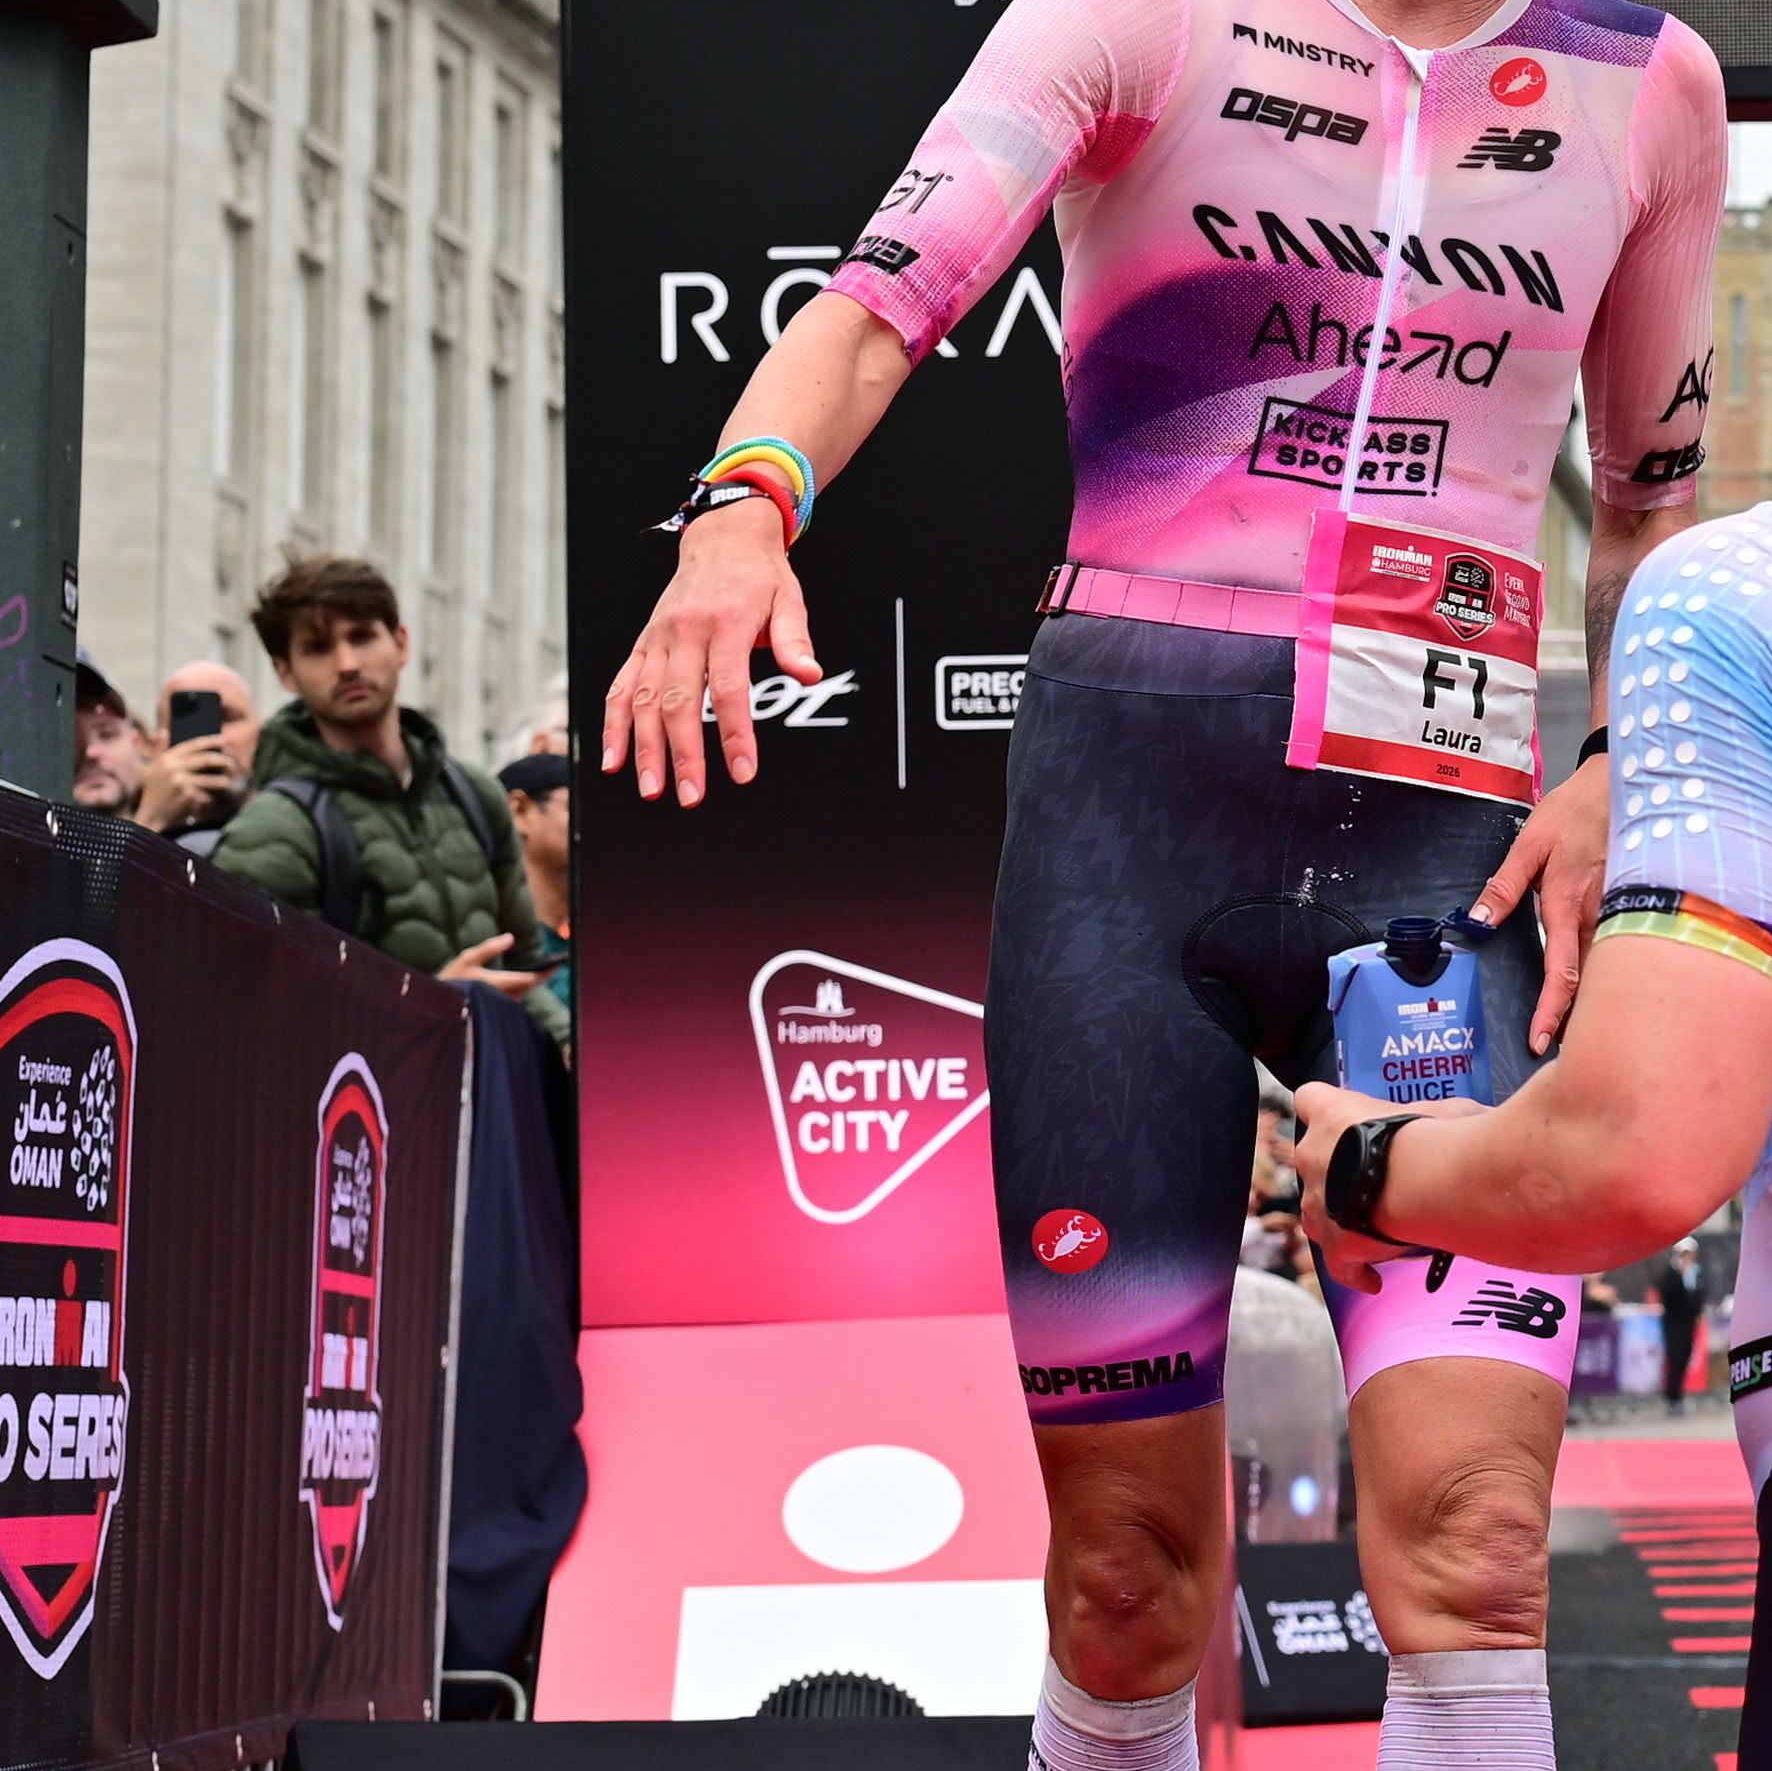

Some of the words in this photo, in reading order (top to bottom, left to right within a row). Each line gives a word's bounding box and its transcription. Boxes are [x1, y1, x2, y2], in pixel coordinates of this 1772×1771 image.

[1264, 34, 1375, 78] MNSTRY
[1192, 204, 1565, 314] CANYON
[1363, 425, 1432, 456] ASS
[1276, 447, 1427, 484] SPORTS
[1381, 559, 1431, 576] HAMBURG
[1436, 601, 1456, 616] PRO
[1458, 607, 1493, 624] SERIES
[1422, 647, 1489, 720] F1
[952, 698, 996, 714] FUEL
[1421, 720, 1483, 754] Laura
[1436, 763, 1461, 778] 2026
[777, 1021, 883, 1047] Hamburg
[1382, 1027, 1474, 1058] AMACX
[19, 1055, 72, 1086] Experience
[790, 1057, 968, 1104] ACTIVE
[1383, 1054, 1473, 1082] CHERRY
[798, 1110, 910, 1153] CITY
[10, 1143, 63, 1190] OMAN
[1019, 1351, 1194, 1396] SOPREMA
